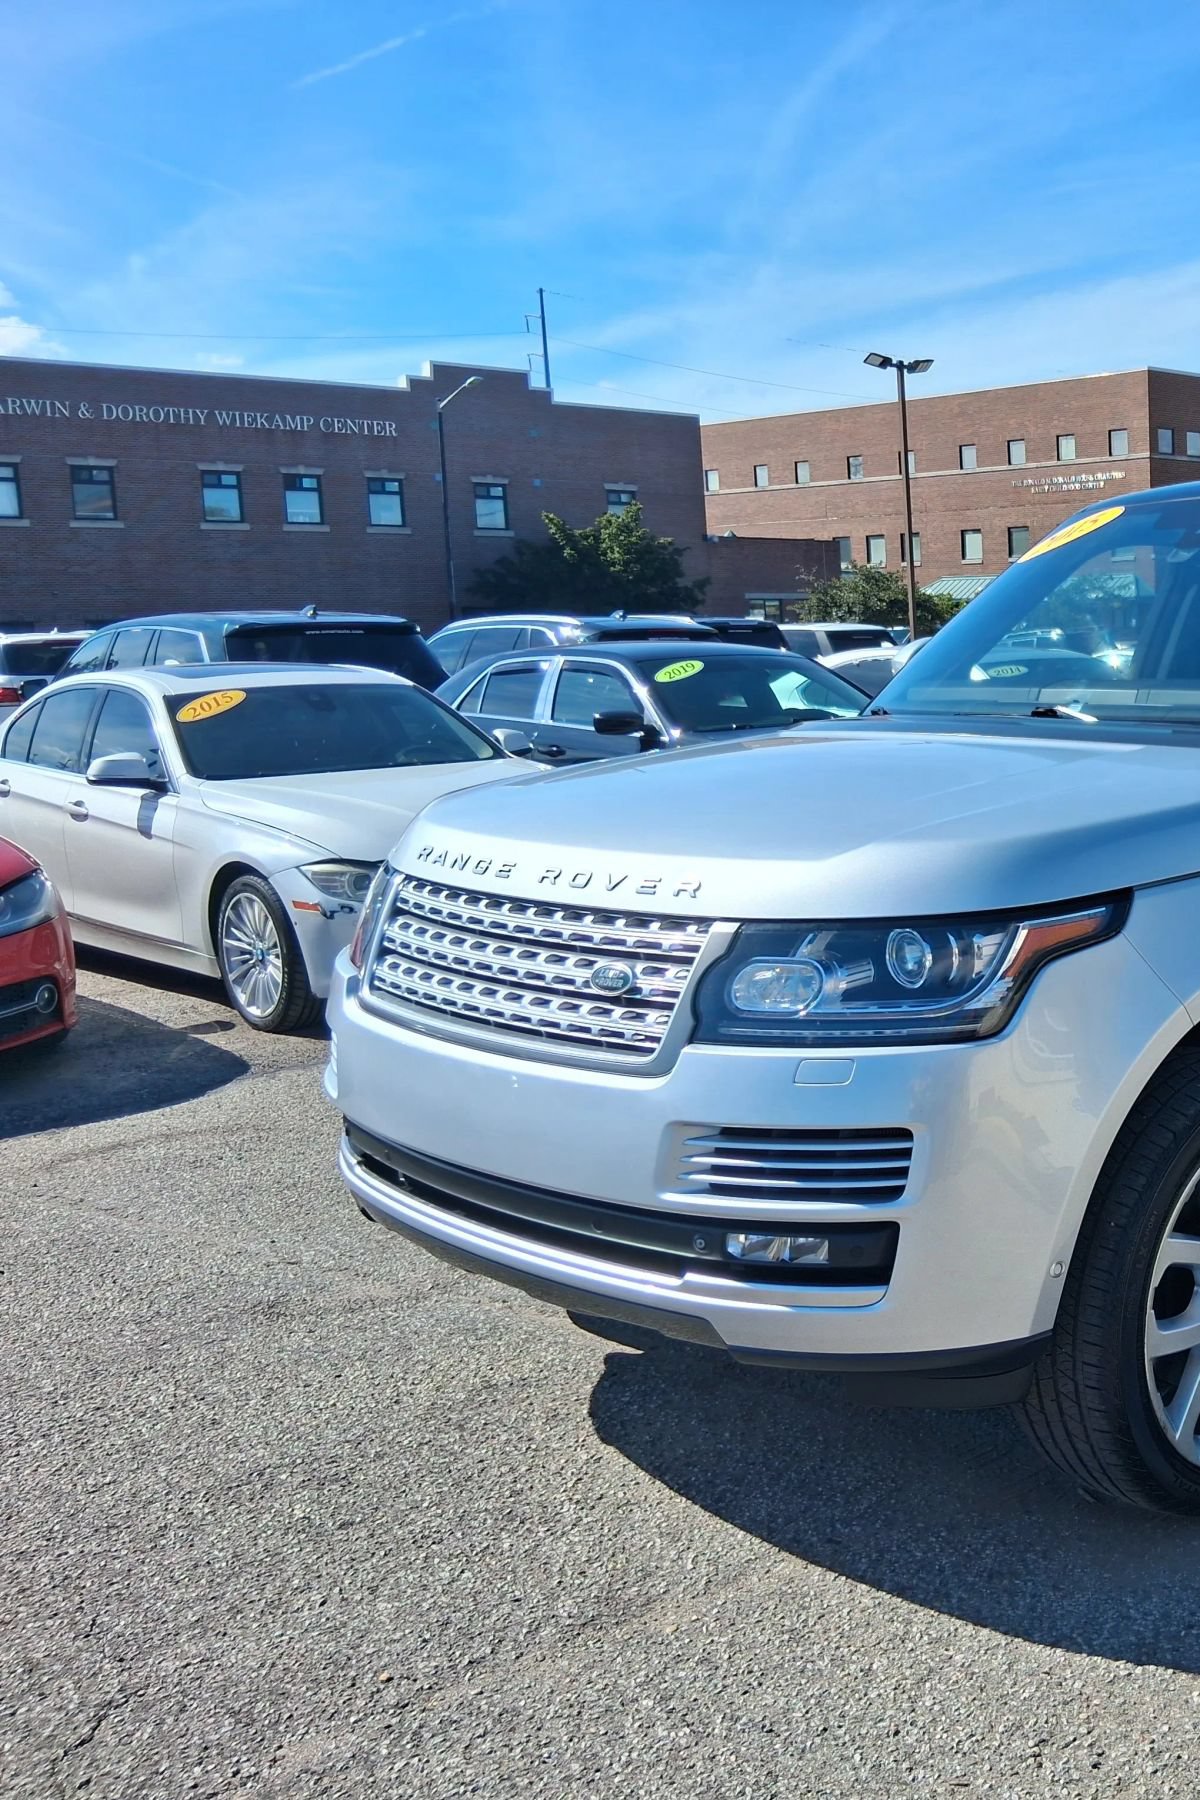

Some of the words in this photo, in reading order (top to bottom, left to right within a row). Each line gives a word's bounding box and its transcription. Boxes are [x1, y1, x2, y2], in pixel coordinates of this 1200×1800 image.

[78, 402, 95, 419] &
[101, 403, 208, 425] DOROTHY
[214, 409, 314, 432] WIEKAMP
[319, 416, 398, 437] CENTER
[664, 662, 696, 680] 2019
[186, 692, 234, 720] 2015
[417, 847, 517, 878] RANGE
[537, 867, 702, 898] ROVER
